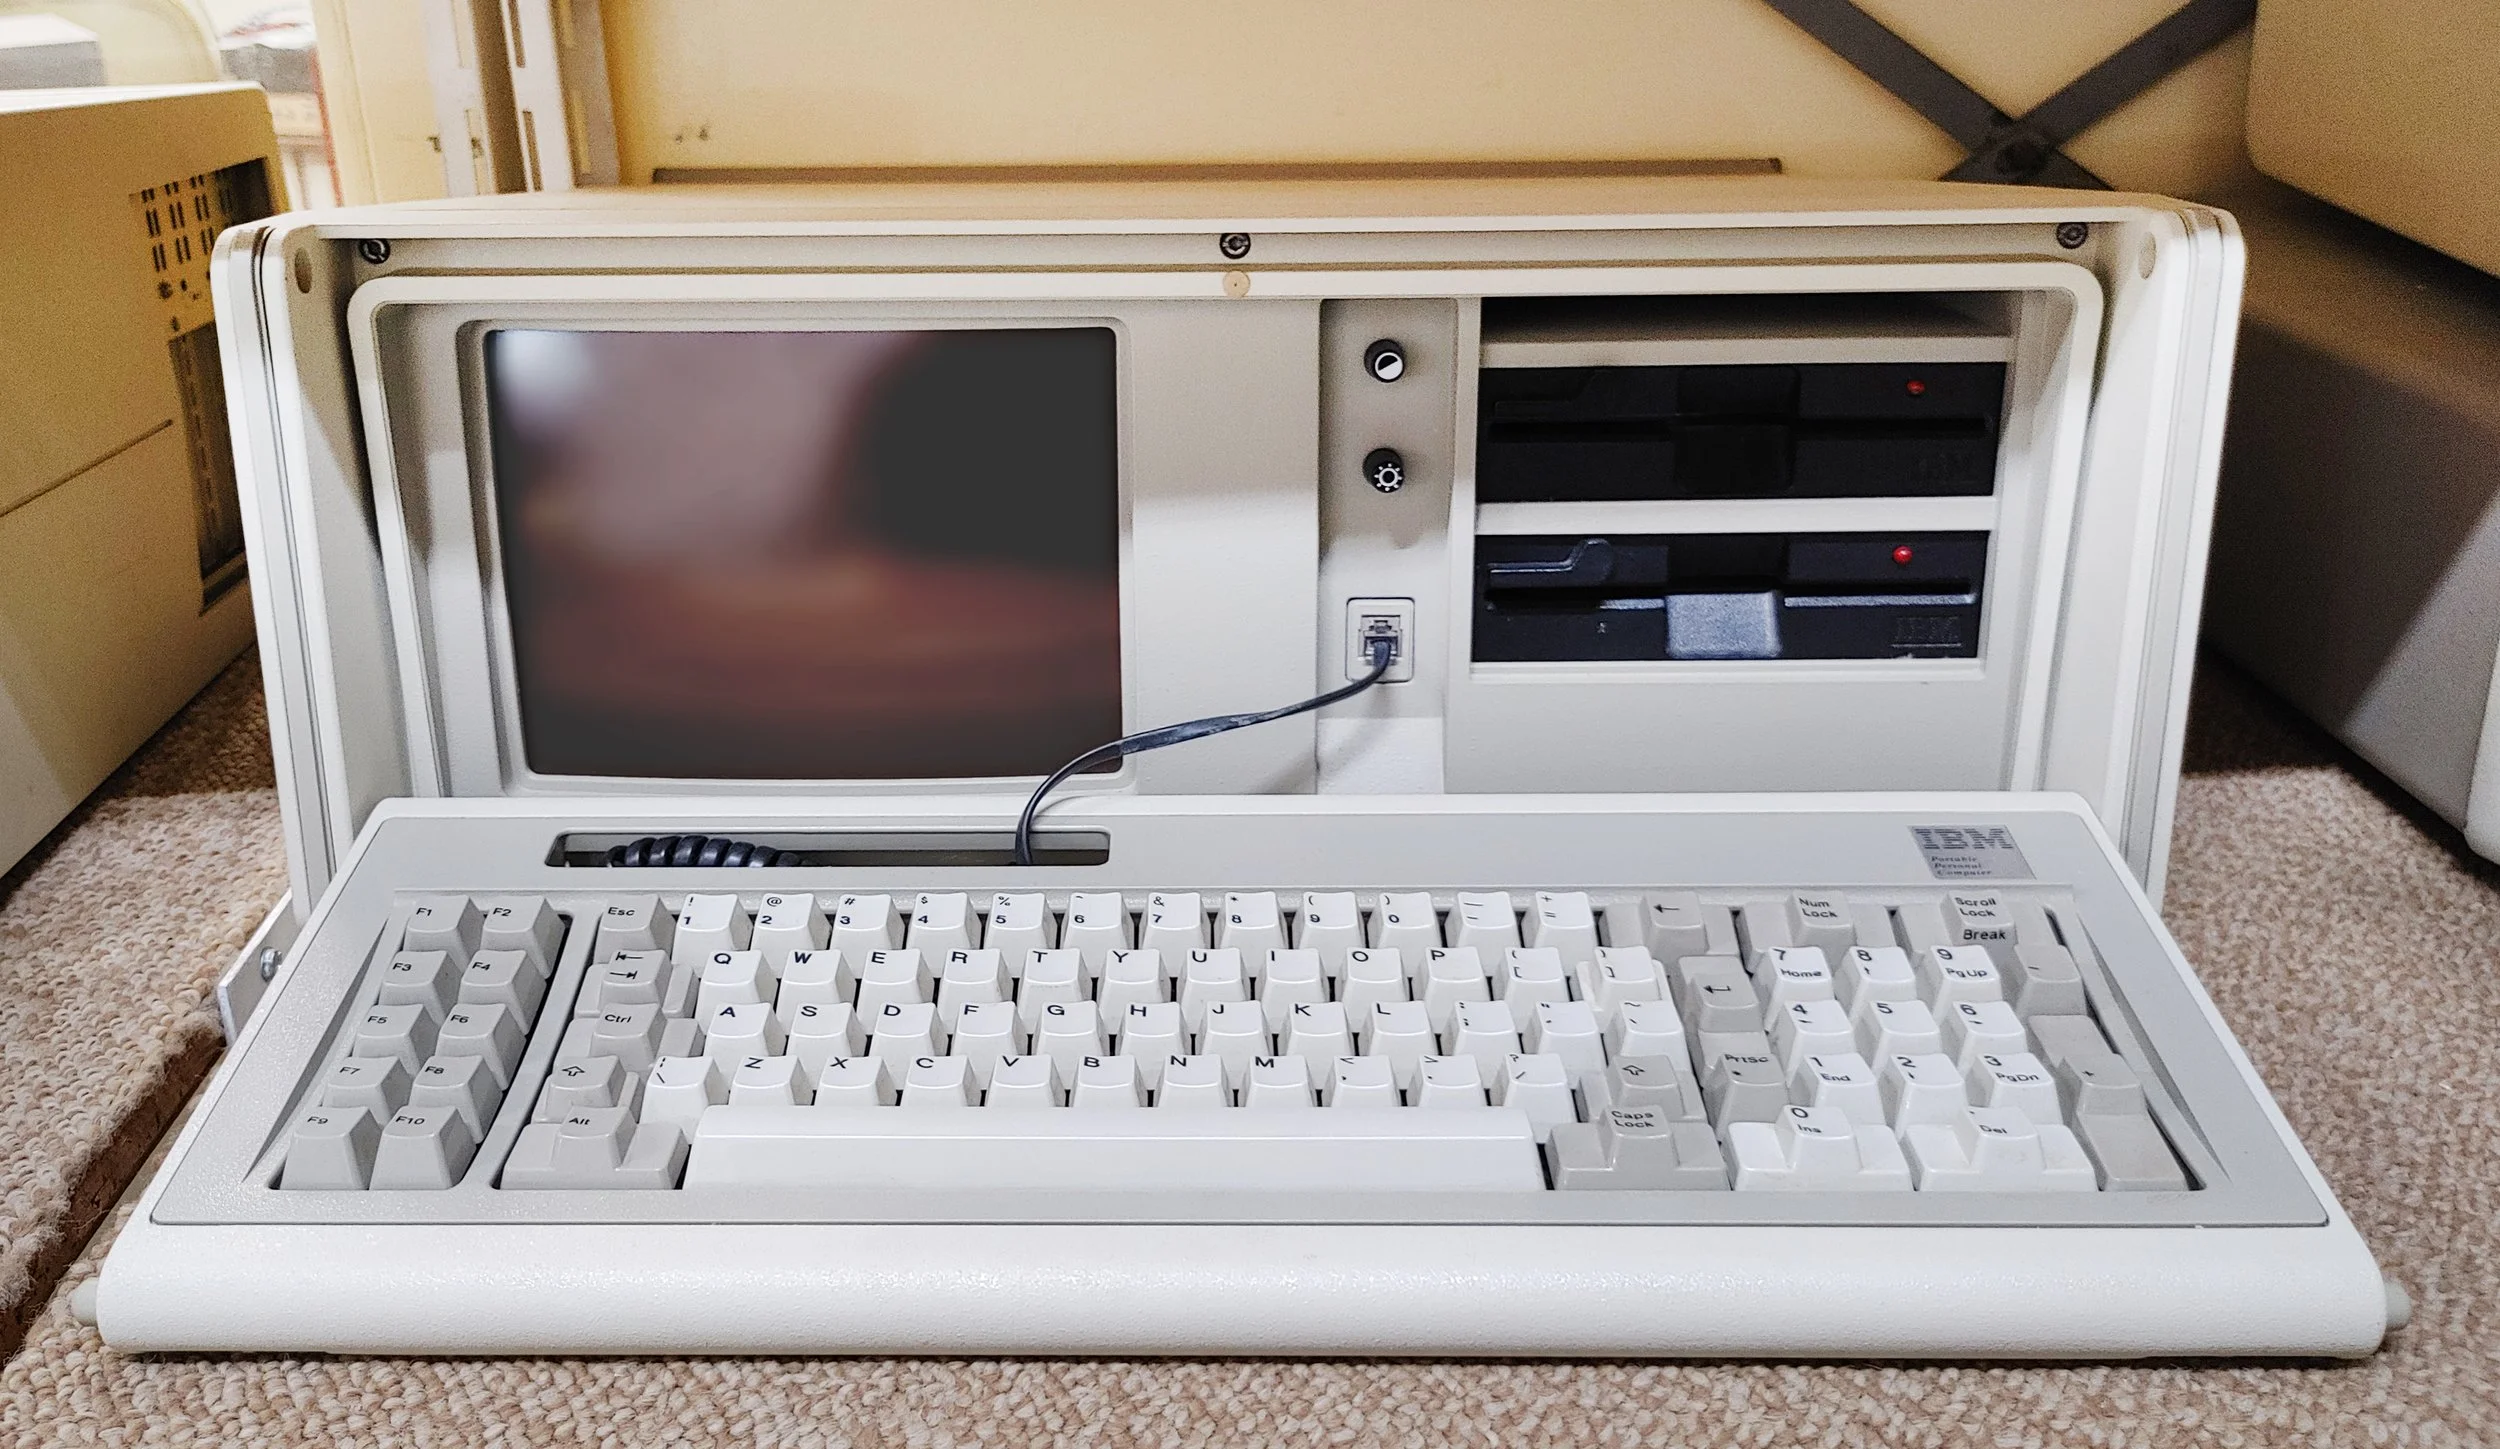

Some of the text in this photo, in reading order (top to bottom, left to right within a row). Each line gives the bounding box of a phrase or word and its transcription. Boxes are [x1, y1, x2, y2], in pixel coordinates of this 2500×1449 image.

[1914, 829, 2013, 849] IBM
[767, 897, 782, 907] @
[998, 896, 1010, 906] %
[1153, 896, 1164, 906] &
[1799, 898, 1830, 907] Num
[1955, 897, 1996, 906] Scroll
[416, 908, 432, 916] F1
[493, 908, 511, 916] F2
[608, 907, 635, 916] Esc
[1802, 908, 1837, 917] Lock
[1959, 908, 1995, 917] Lock
[684, 916, 691, 925] 1
[761, 916, 772, 924] 2
[840, 916, 850, 924] 3
[918, 915, 928, 923] 4
[996, 915, 1006, 924] 5
[1074, 915, 1084, 923] 6
[1153, 914, 1162, 923] 7
[1232, 915, 1242, 923] 8
[1310, 914, 1320, 923] 9
[1963, 929, 2005, 940] Break
[714, 953, 731, 964] Q
[795, 952, 812, 964] W
[871, 952, 886, 964] E
[952, 951, 968, 963] R
[1033, 951, 1048, 963] T
[1113, 951, 1128, 963] Y
[1192, 951, 1207, 962] U
[1271, 951, 1275, 961] I
[1352, 951, 1368, 962] O
[1431, 950, 1445, 960] P
[1773, 949, 1786, 960] 7
[1857, 950, 1872, 961] 8
[1937, 949, 1953, 960] 9
[392, 963, 412, 971] F3
[472, 962, 490, 970] F4
[1781, 969, 1822, 977] Home
[720, 1007, 735, 1017] A
[801, 1006, 817, 1017] S
[884, 1005, 901, 1016] D
[964, 1005, 979, 1015] F
[1047, 1005, 1065, 1015] G
[1130, 1005, 1146, 1017] H
[1212, 1004, 1224, 1014] J
[1295, 1004, 1311, 1016] K
[1377, 1003, 1391, 1015] L
[1793, 1004, 1807, 1014] 4
[1877, 1003, 1893, 1014] 5
[1960, 1004, 1977, 1015] 6
[368, 1016, 387, 1024] F5
[451, 1015, 469, 1023] F6
[605, 1014, 631, 1023] Ctrl
[745, 1057, 763, 1069] Z
[830, 1057, 848, 1069] X
[916, 1058, 934, 1068] C
[1003, 1056, 1019, 1067] V
[1084, 1057, 1100, 1067] B
[1171, 1055, 1186, 1067] N
[1255, 1056, 1274, 1068] M
[1811, 1057, 1822, 1067] 1
[1897, 1057, 1916, 1068] 2
[1984, 1056, 2002, 1066] 3
[340, 1067, 360, 1075] F7
[425, 1066, 444, 1074] F8
[1820, 1073, 1851, 1081] End
[1996, 1073, 2039, 1082] PgDn
[307, 1116, 328, 1124] F9
[396, 1116, 425, 1125] F10
[1611, 1111, 1653, 1120] Caps
[1614, 1119, 1654, 1128] Lock
[1797, 1124, 1822, 1133] Ins
[1979, 1125, 2007, 1134] Del
